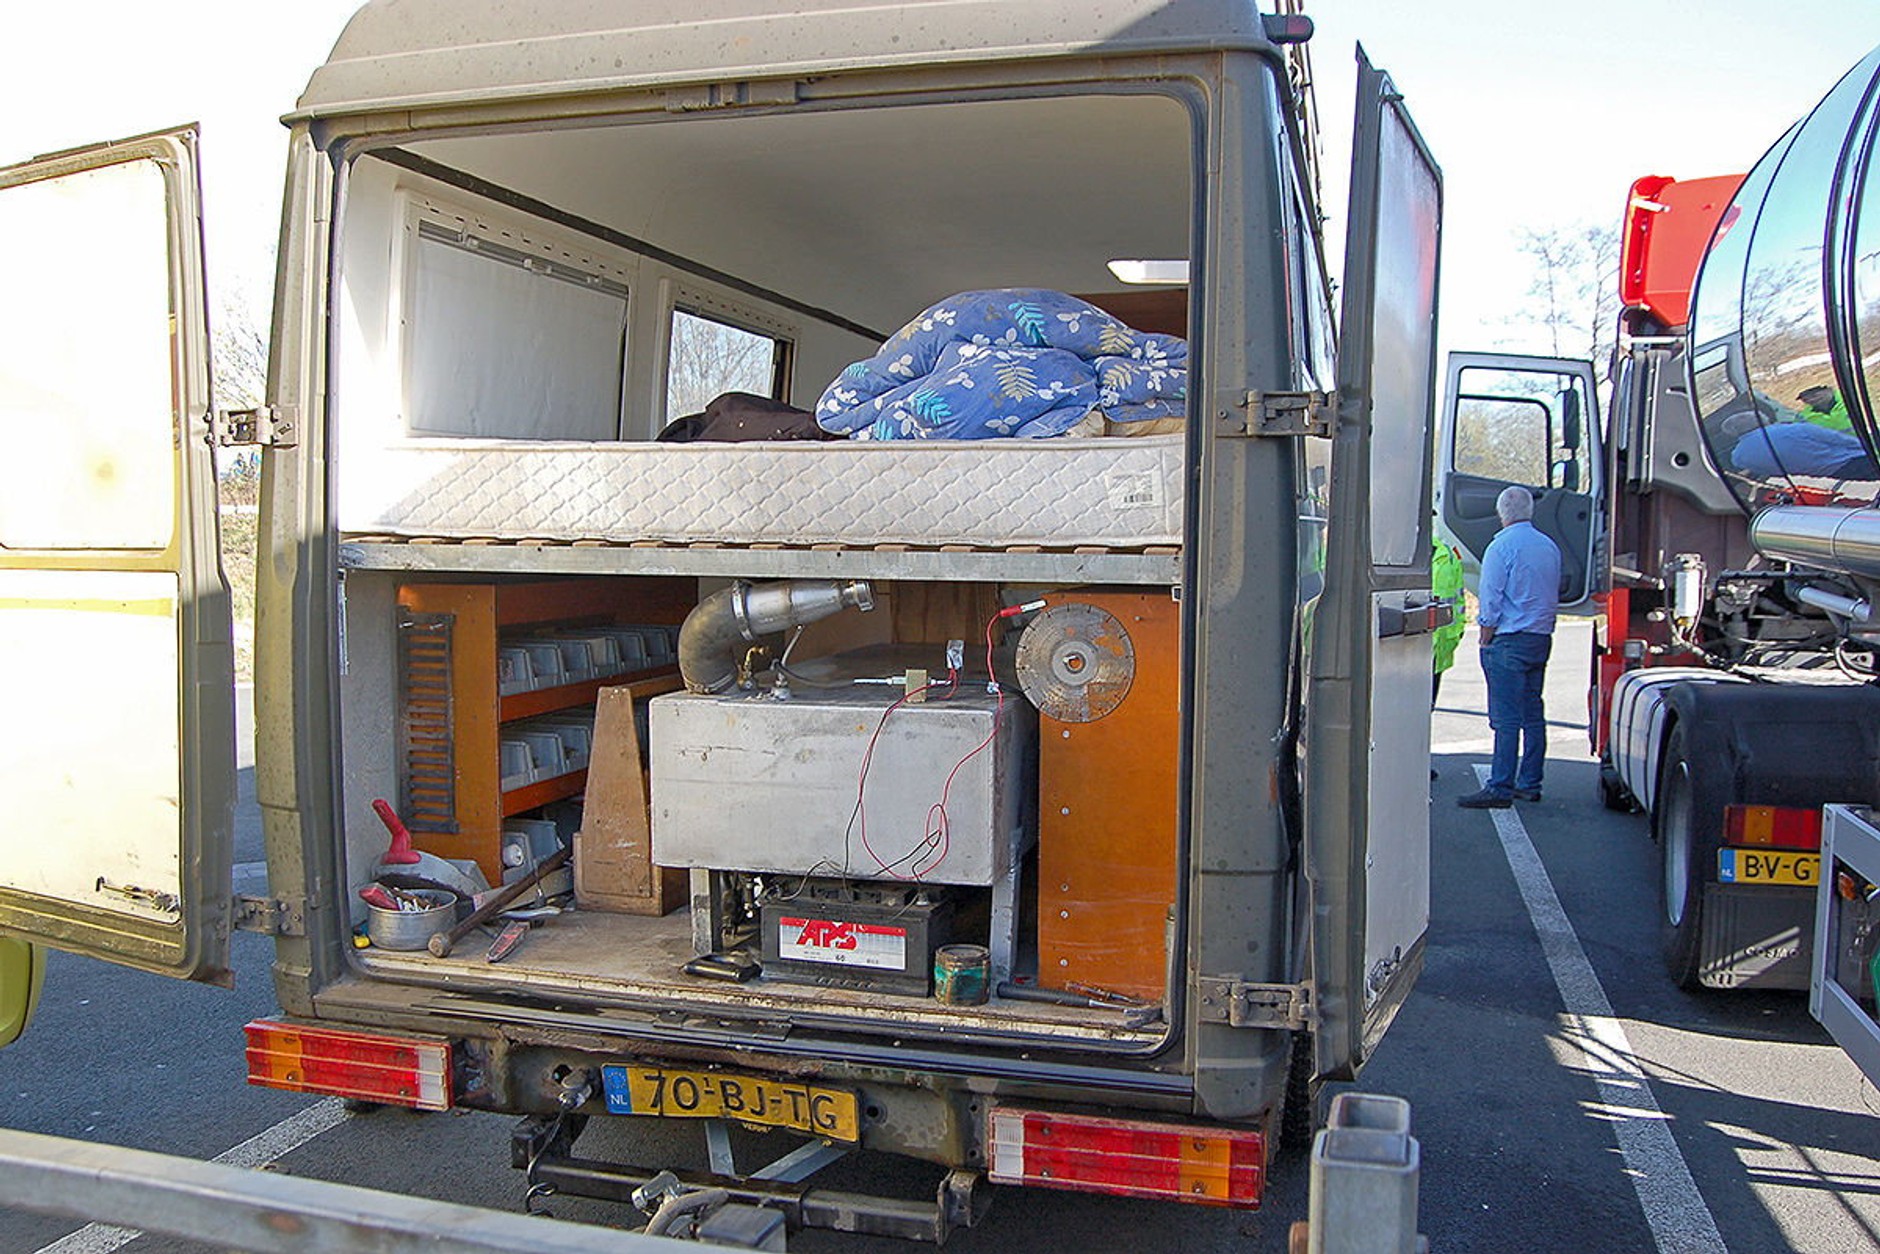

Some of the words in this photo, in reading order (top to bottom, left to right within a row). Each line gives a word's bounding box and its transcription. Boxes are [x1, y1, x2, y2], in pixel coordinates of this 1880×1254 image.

[1721, 868, 1734, 878] NL
[1745, 855, 1820, 881] BV-G
[609, 1093, 628, 1106] NL
[643, 1069, 837, 1131] 70-BJ-TG
